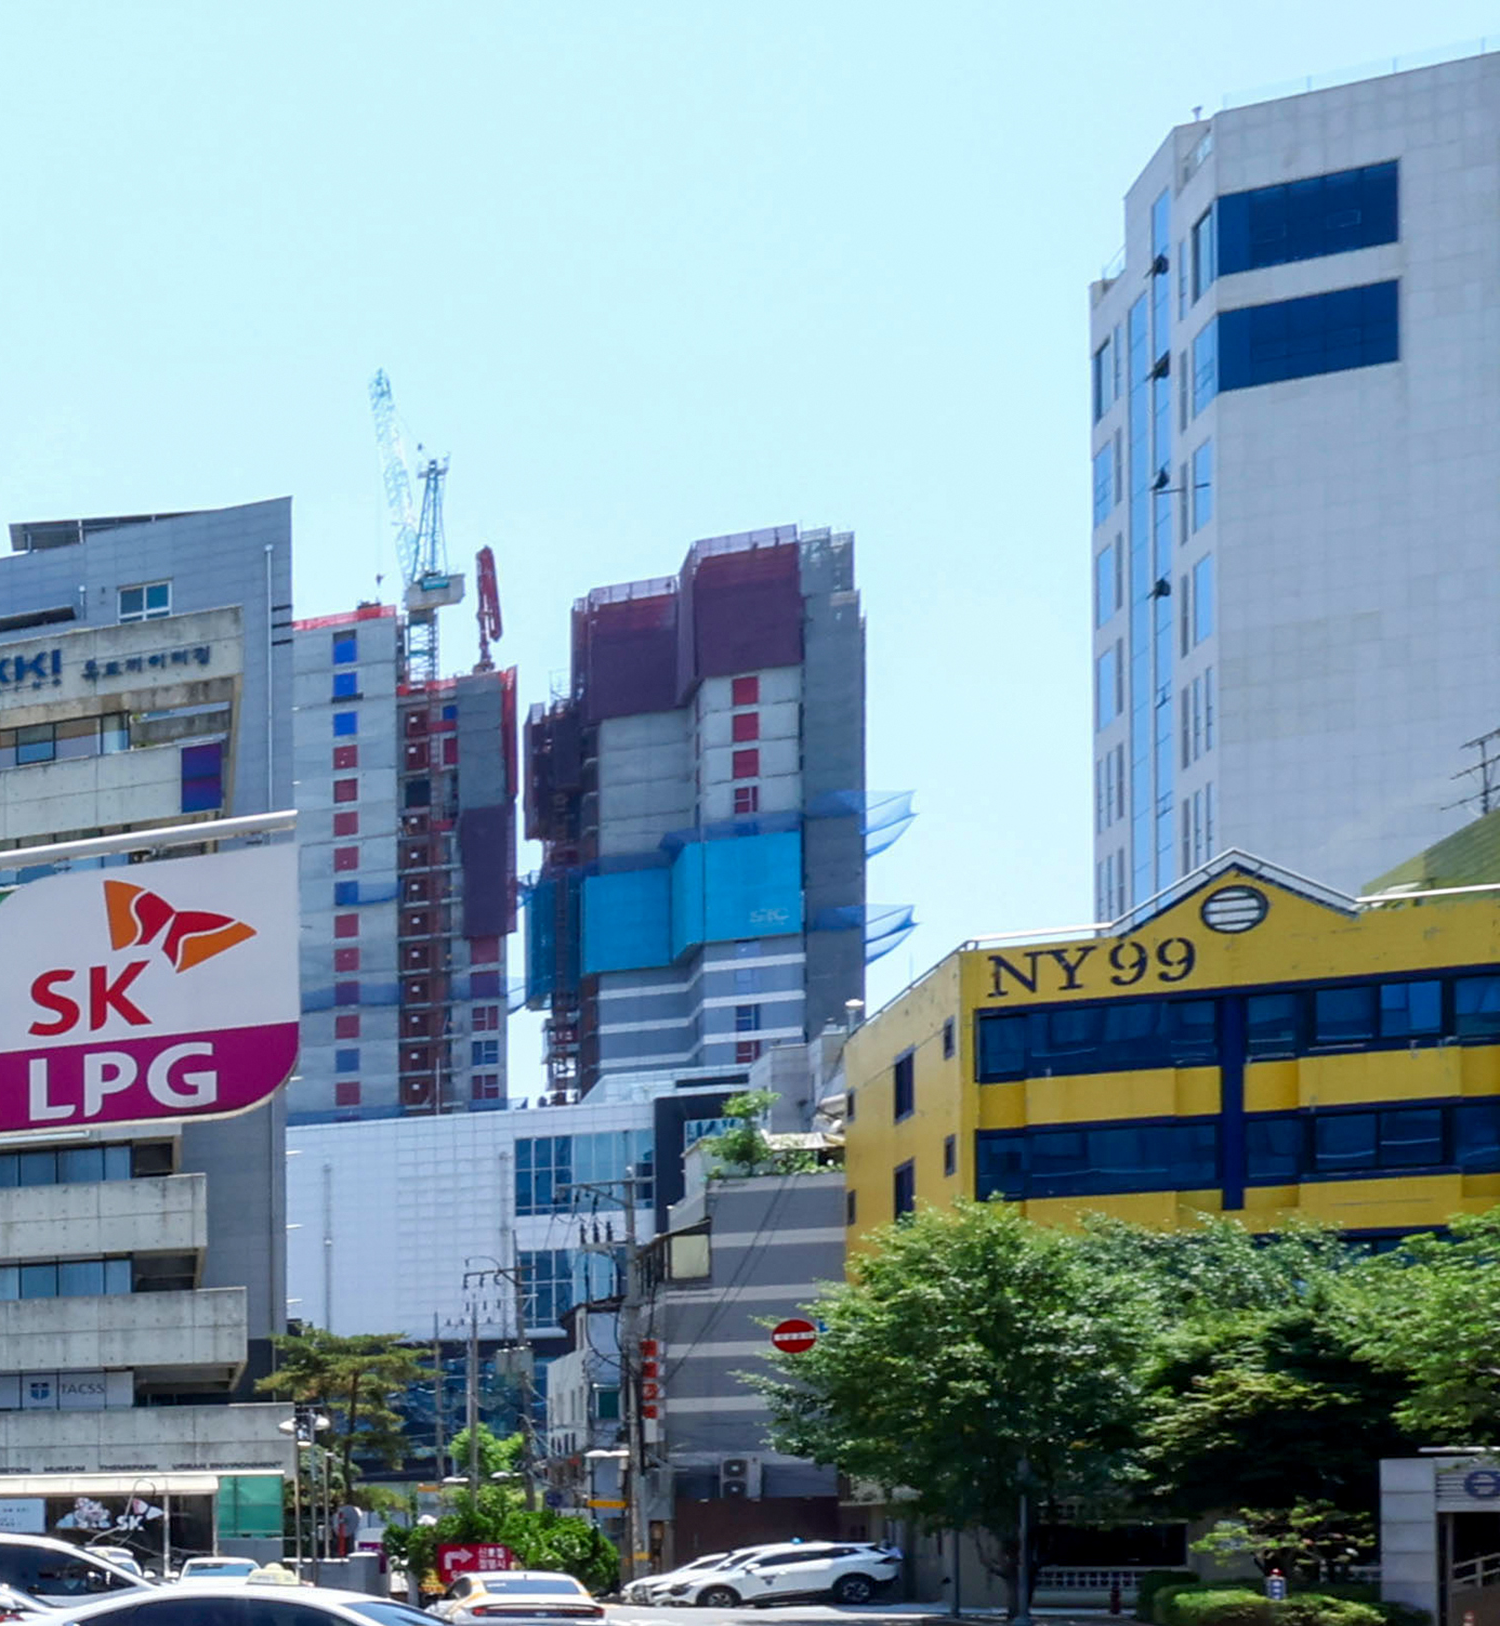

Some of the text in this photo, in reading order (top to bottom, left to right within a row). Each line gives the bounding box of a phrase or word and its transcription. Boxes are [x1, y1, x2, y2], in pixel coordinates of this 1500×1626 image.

[28, 959, 152, 1037] SK
[28, 1040, 218, 1122] LPG
[116, 1514, 145, 1532] SK
